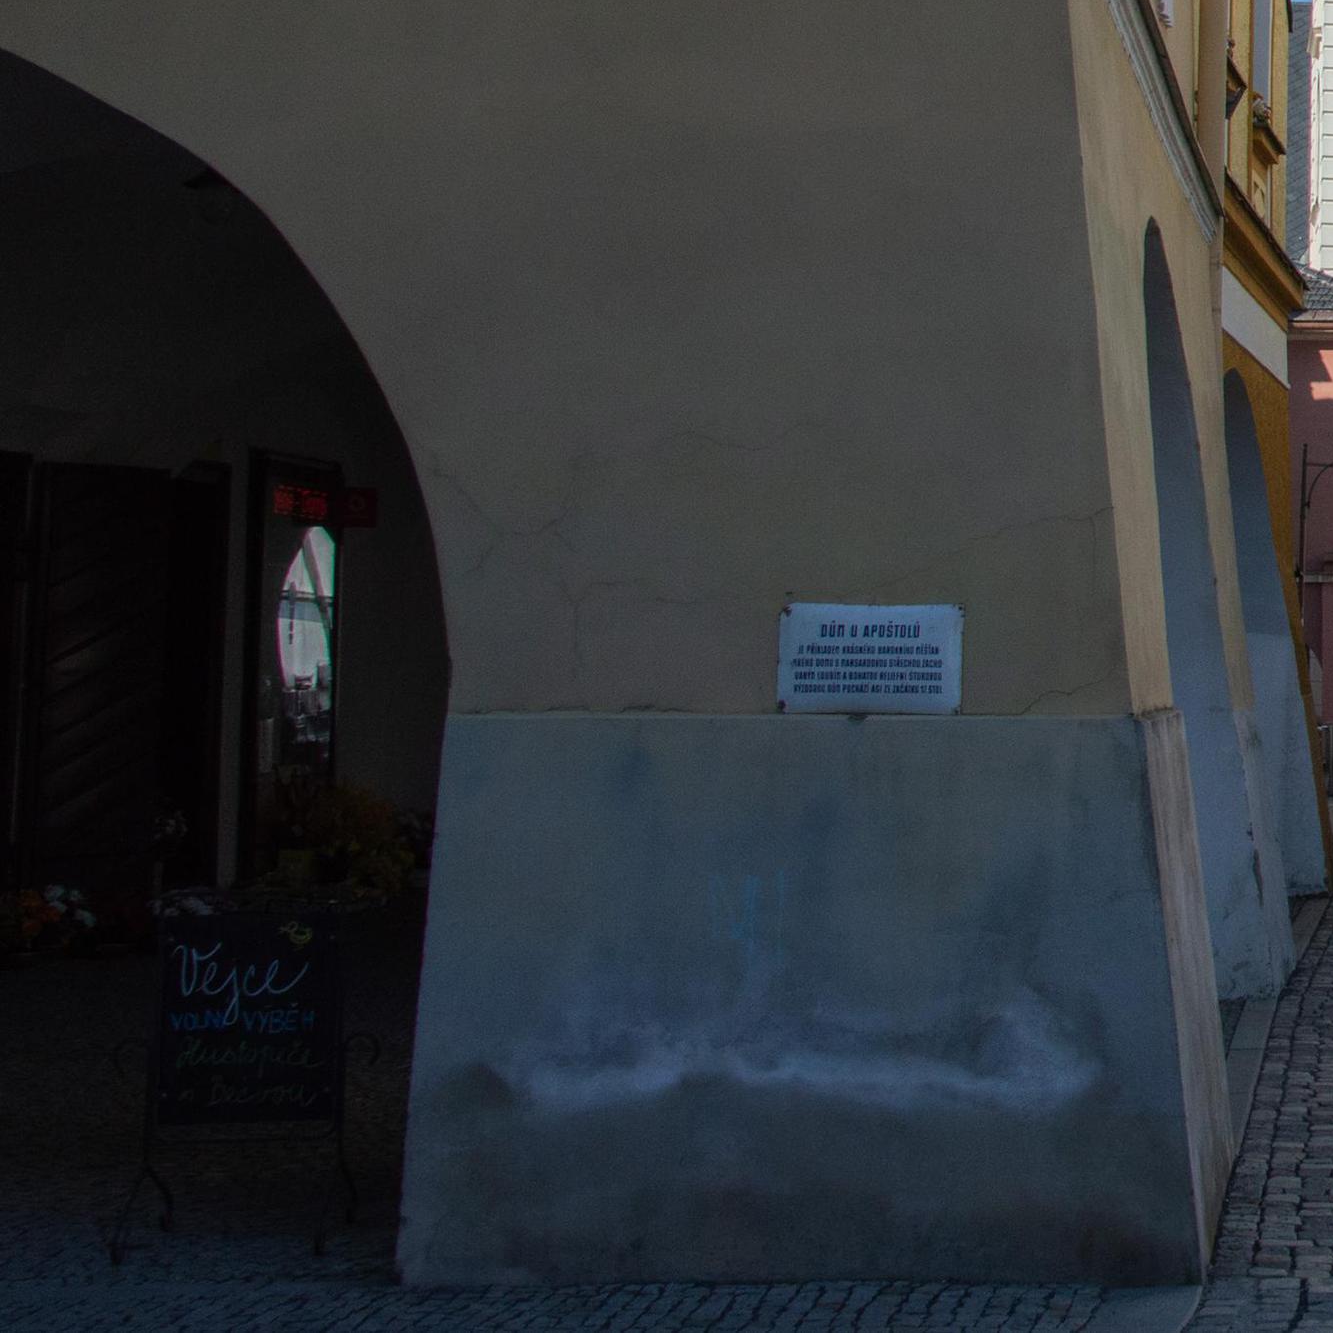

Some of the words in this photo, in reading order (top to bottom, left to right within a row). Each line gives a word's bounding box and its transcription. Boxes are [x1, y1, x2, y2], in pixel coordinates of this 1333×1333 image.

[820, 620, 845, 638] DŮM
[850, 624, 858, 638] U
[862, 620, 921, 638] APOŠTOLŮ
[172, 941, 310, 1027] Vejce
